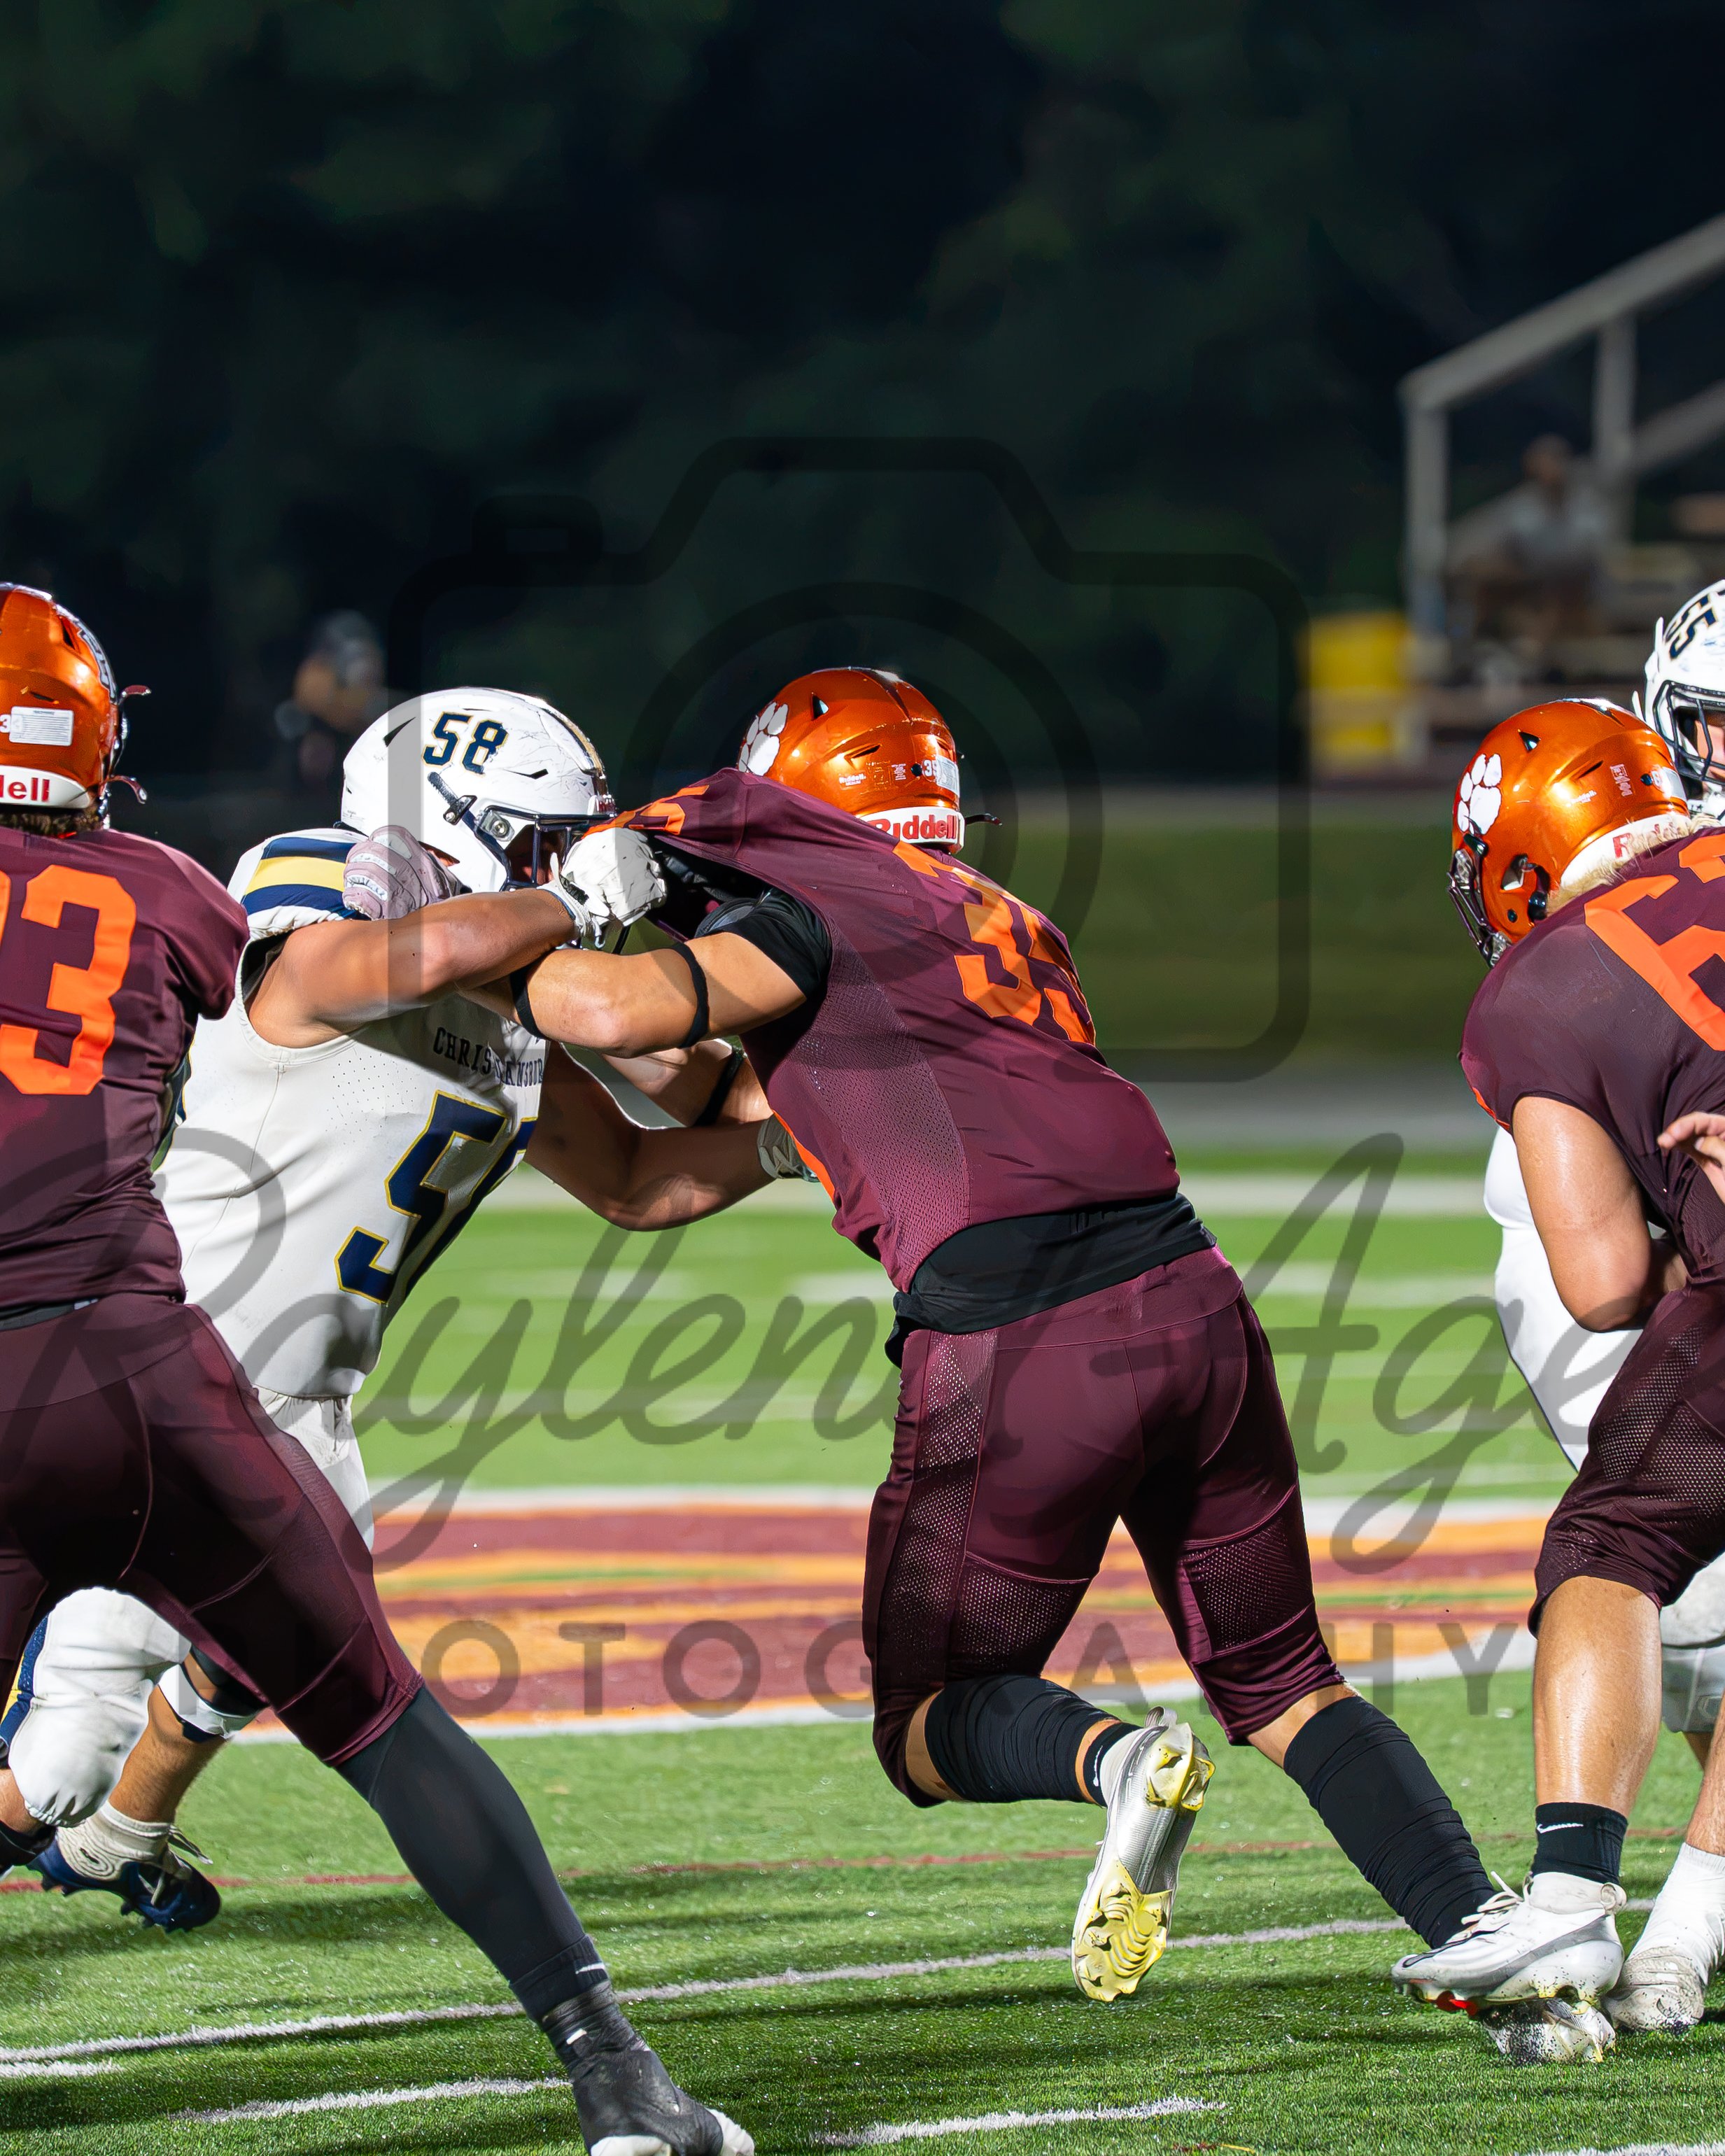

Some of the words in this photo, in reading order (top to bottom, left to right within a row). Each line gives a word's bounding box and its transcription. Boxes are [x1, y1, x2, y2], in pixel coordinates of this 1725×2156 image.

[421, 711, 509, 777] 58
[0, 775, 50, 802] ell
[0, 864, 137, 1095] 3
